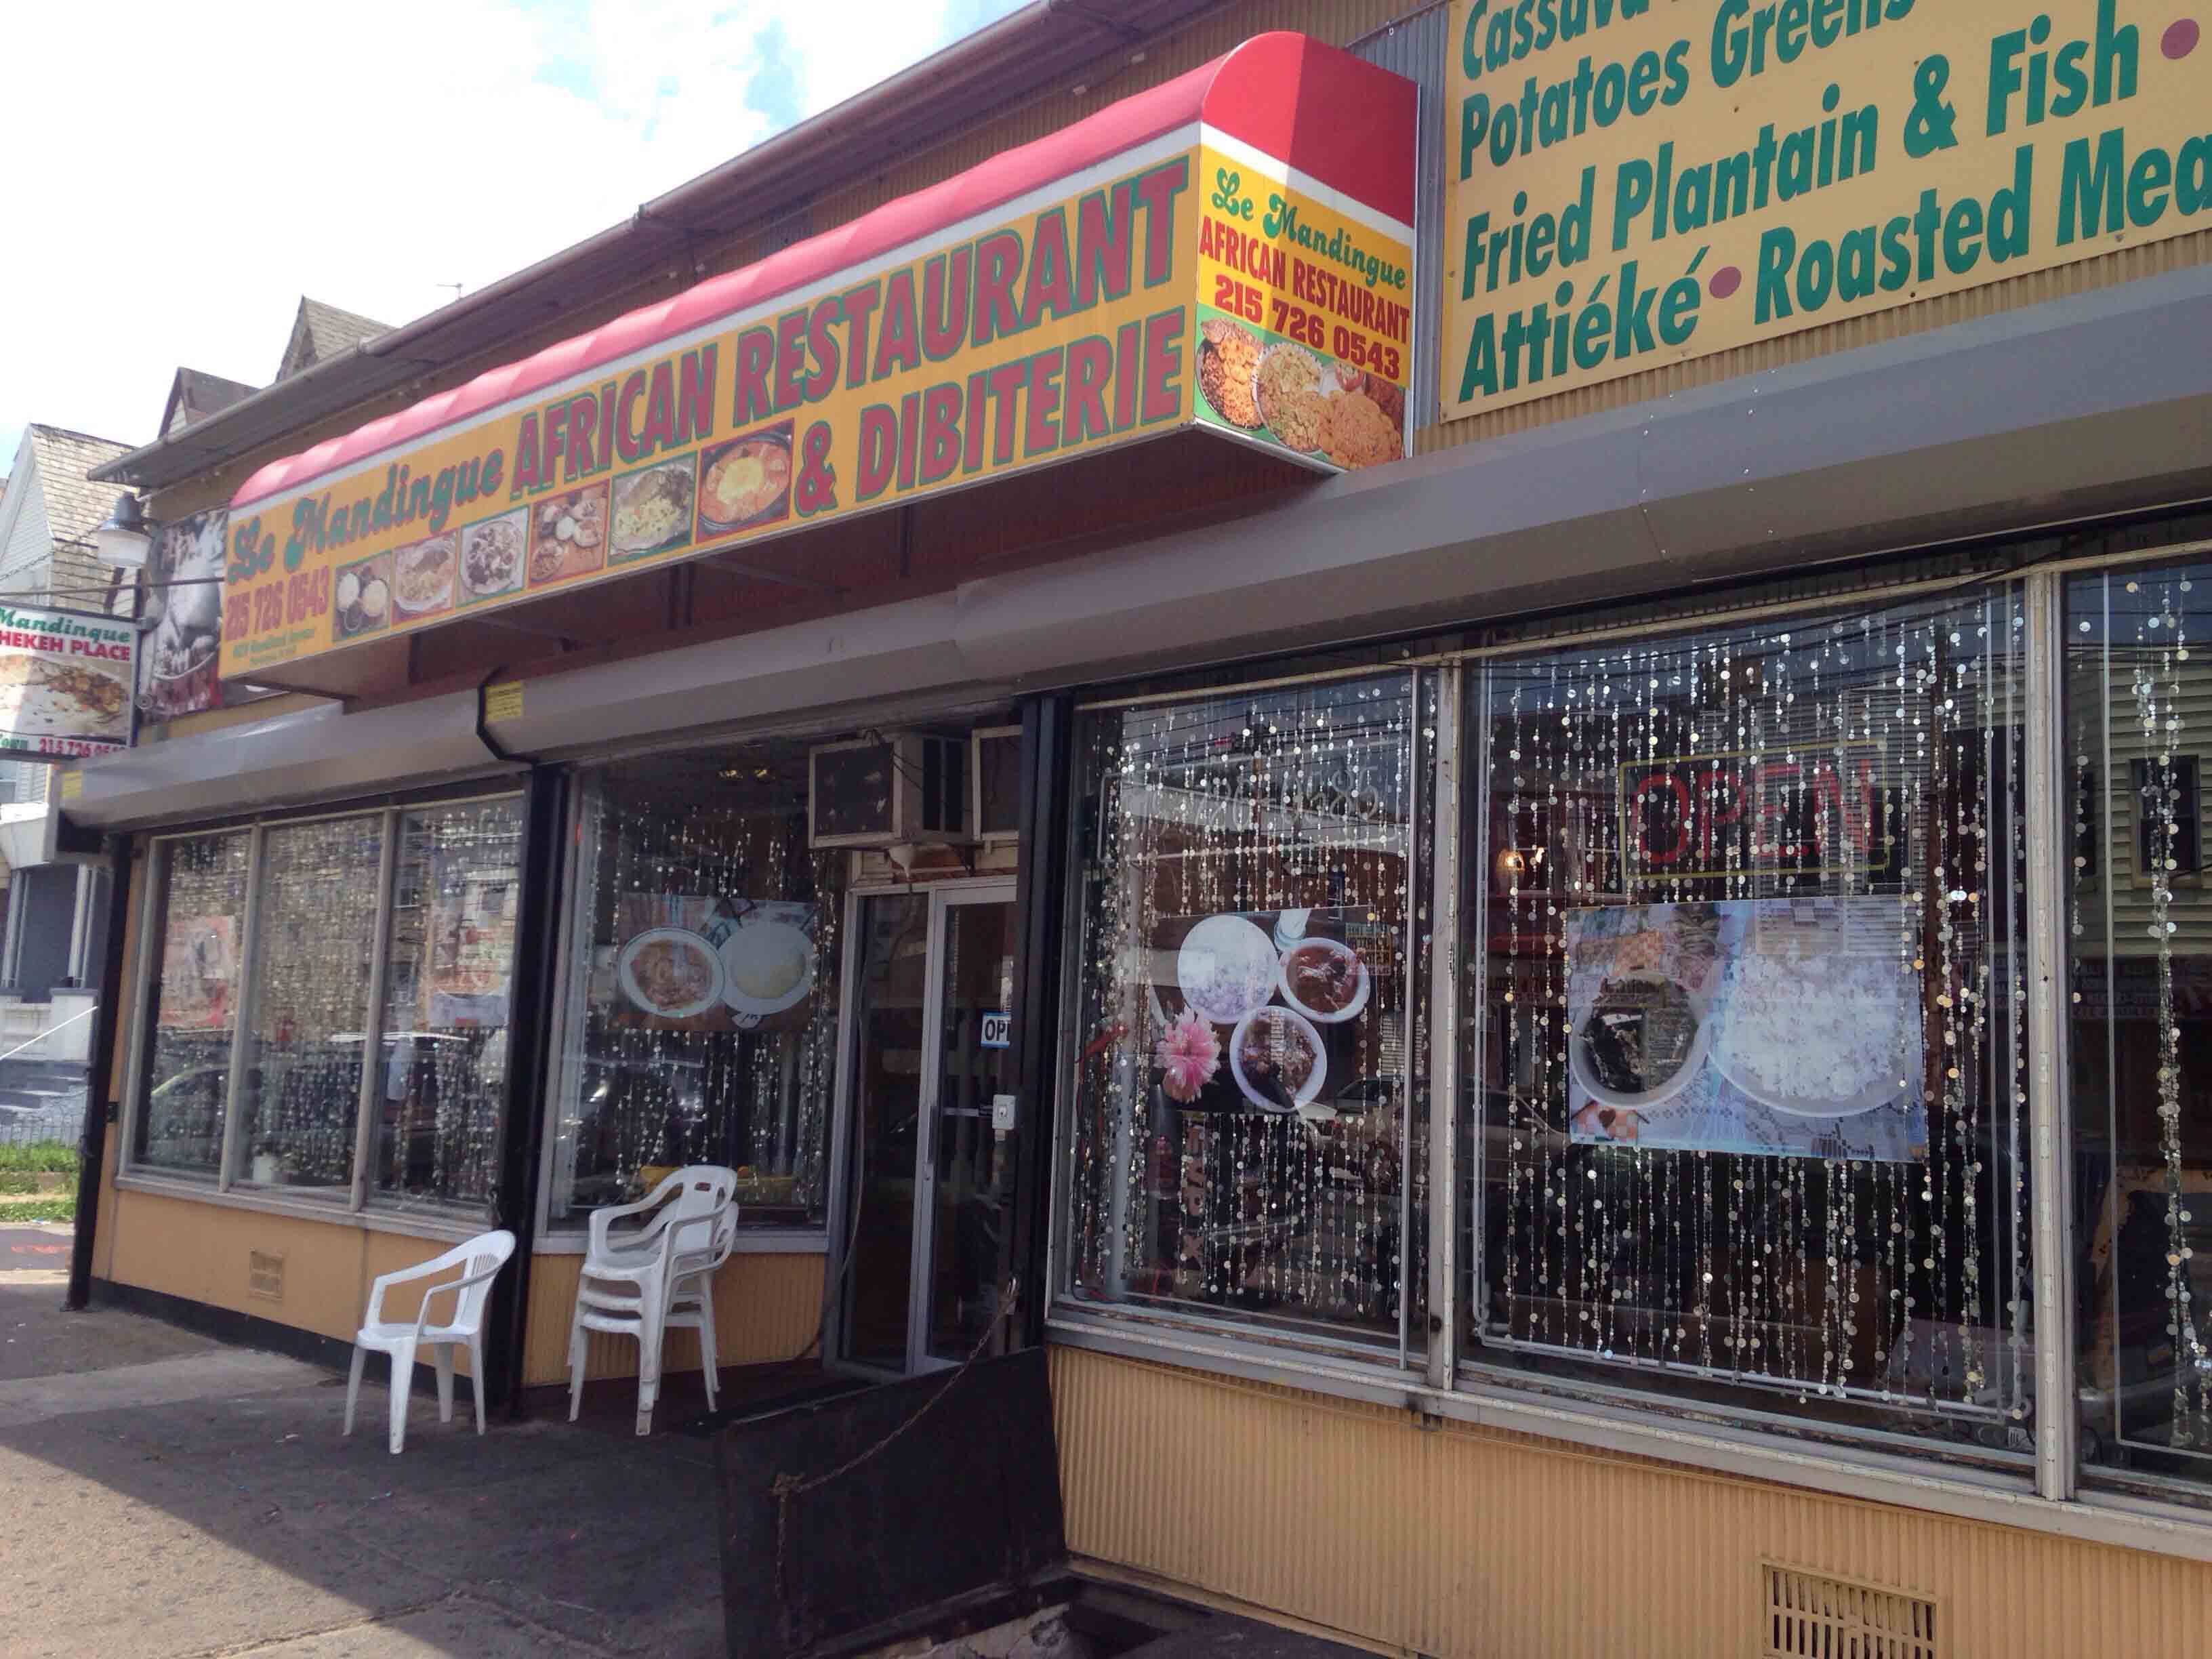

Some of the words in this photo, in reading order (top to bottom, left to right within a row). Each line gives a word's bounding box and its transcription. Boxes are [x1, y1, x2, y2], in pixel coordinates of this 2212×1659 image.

[1459, 39, 1690, 182] Potatoes
[1462, 165, 1595, 301] Fried
[1612, 83, 1878, 251] Plantain
[1904, 54, 1958, 159] &
[1986, 0, 2139, 137] Fish
[1199, 215, 1286, 291] AFRICAN
[1292, 257, 1410, 344] RESTAURANT
[1210, 167, 1254, 221] Le
[1263, 193, 1406, 289] Mandingue
[1458, 245, 1711, 404] Attiéké
[1754, 143, 2034, 325] Roasted
[509, 342, 718, 503] AFRICAN
[733, 155, 1189, 428] RESTAURANT
[1214, 274, 1263, 324] 215
[1271, 298, 1324, 350] 726
[1333, 325, 1400, 380] 0543
[794, 420, 838, 518] &
[855, 306, 1186, 503] DIBITERIE
[227, 516, 274, 586] Le
[283, 447, 505, 572] Mandingue
[70, 638, 131, 662] PLACE
[224, 592, 250, 641] 215
[254, 580, 283, 634] 726
[1631, 758, 1875, 864] OPEN
[984, 1019, 1009, 1042] OP
